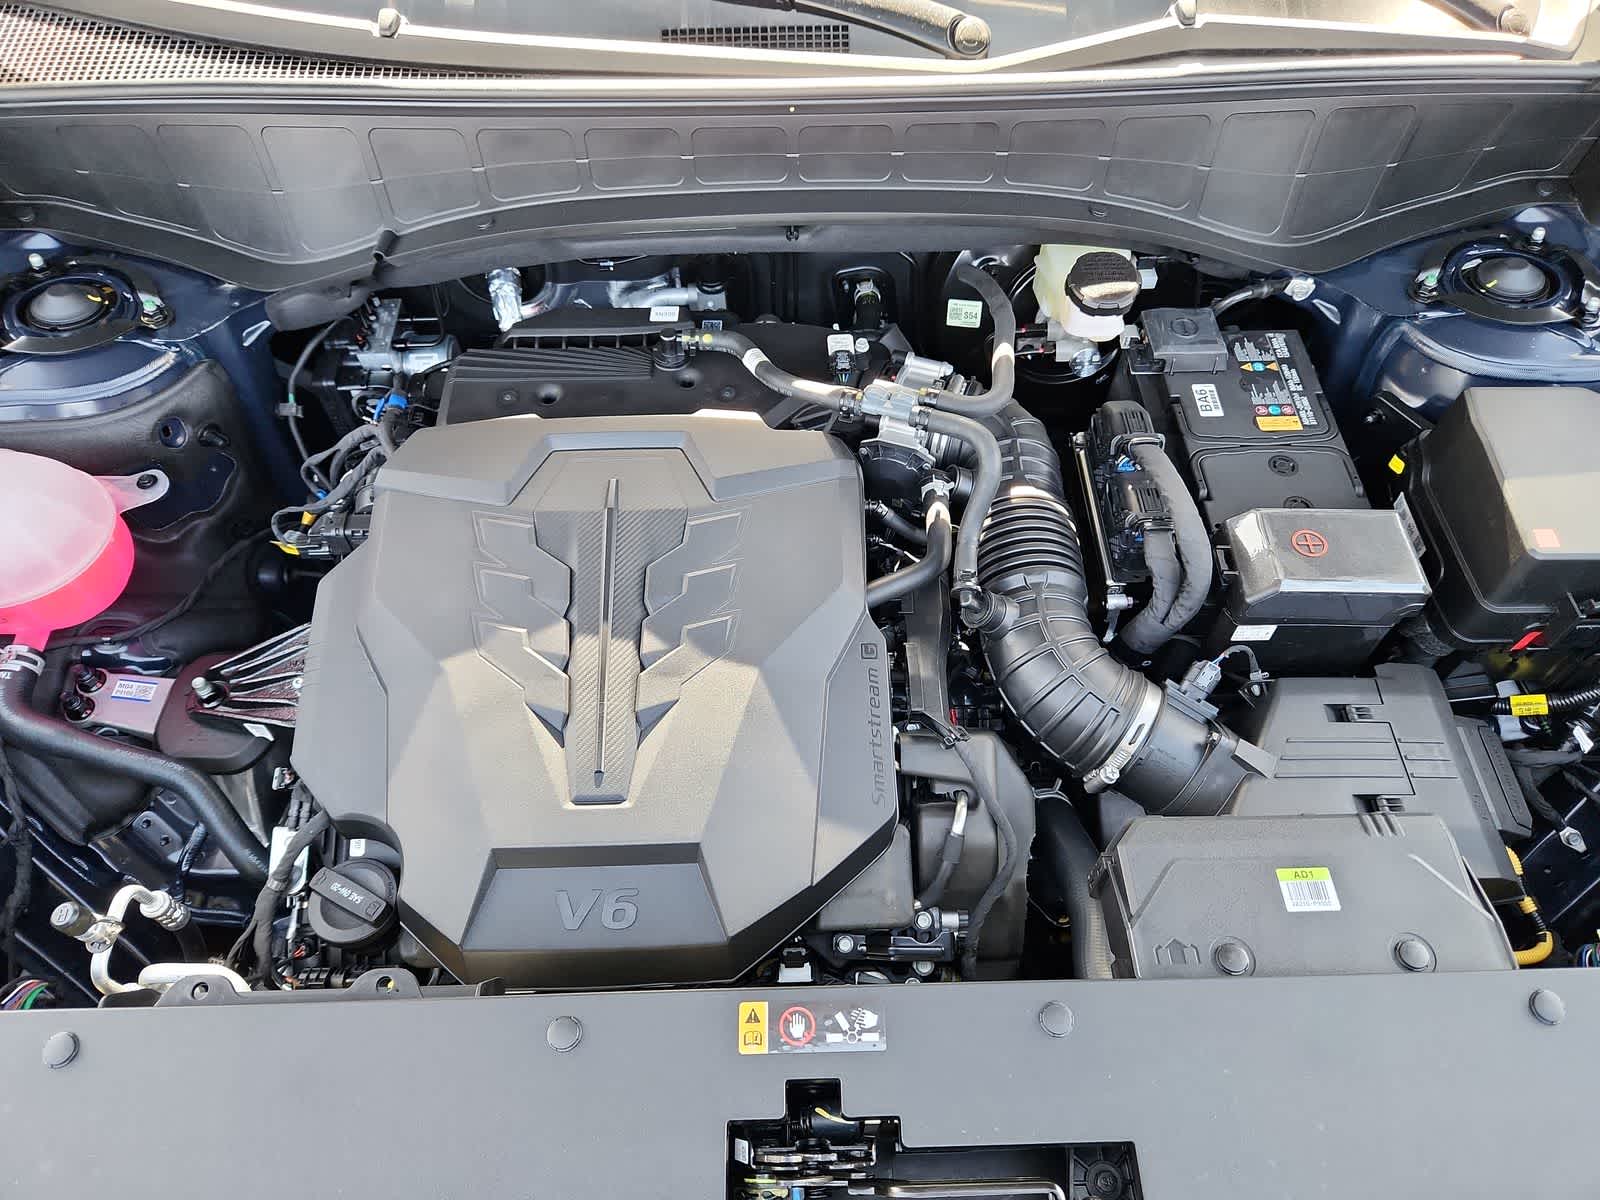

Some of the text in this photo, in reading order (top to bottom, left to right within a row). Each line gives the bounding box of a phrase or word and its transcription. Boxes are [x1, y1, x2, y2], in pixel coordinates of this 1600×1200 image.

[963, 311, 978, 320] S54
[1195, 389, 1213, 411] BA6
[868, 667, 886, 809] Smartstream
[1294, 870, 1314, 879] AD1
[348, 892, 364, 904] SAE
[553, 887, 639, 930] V6
